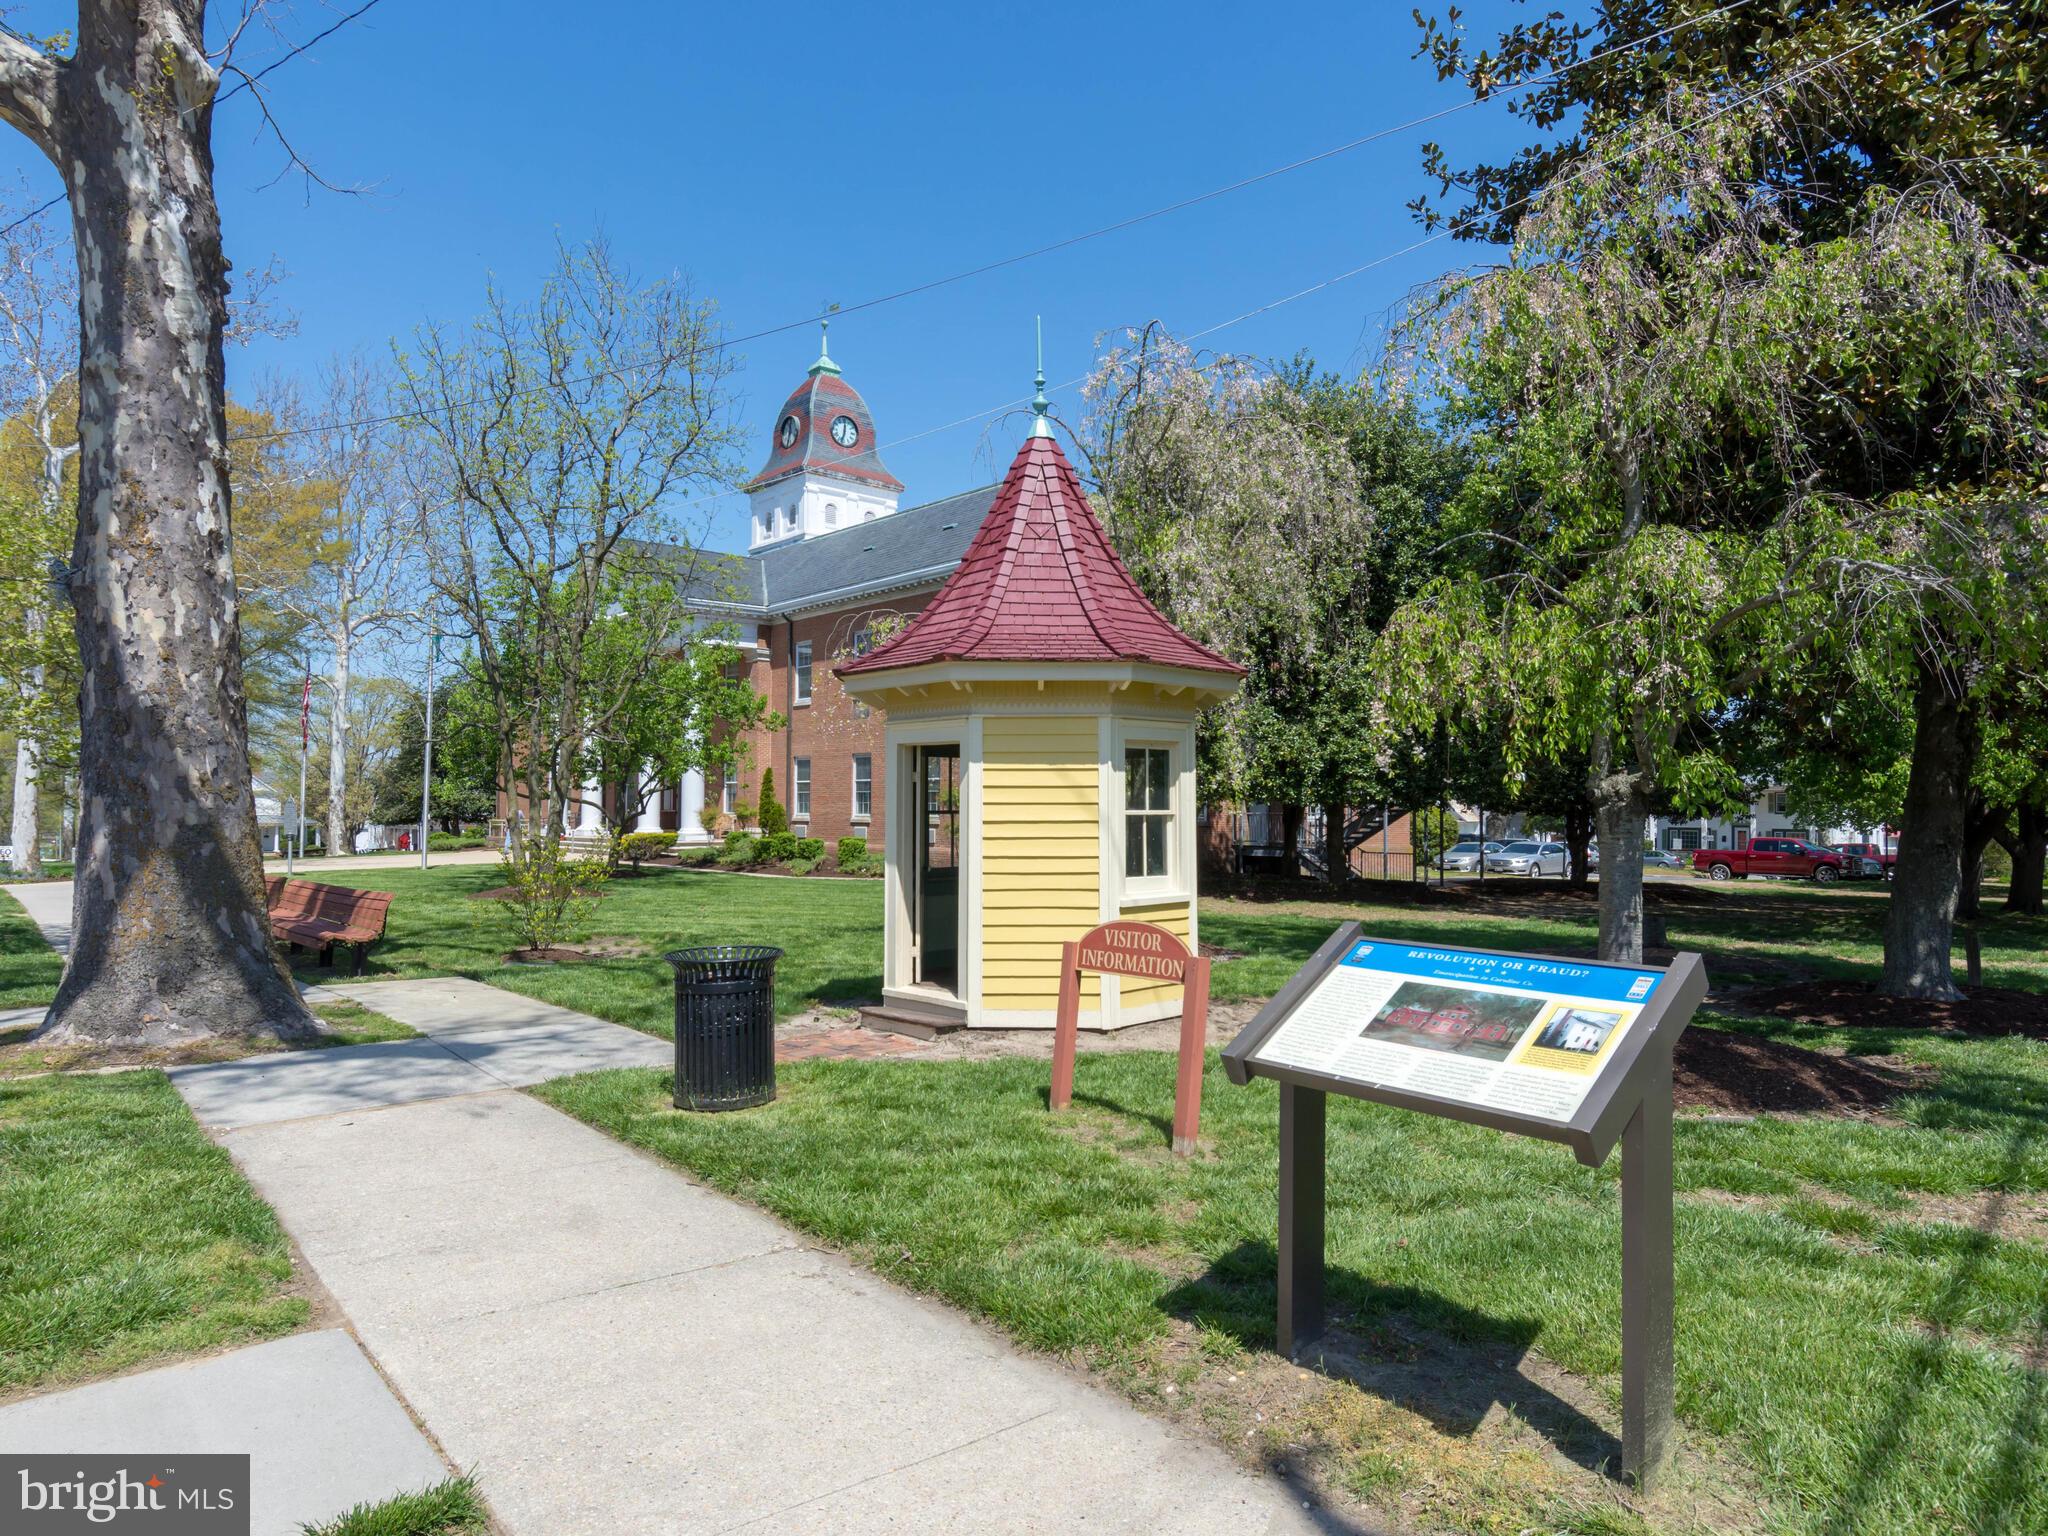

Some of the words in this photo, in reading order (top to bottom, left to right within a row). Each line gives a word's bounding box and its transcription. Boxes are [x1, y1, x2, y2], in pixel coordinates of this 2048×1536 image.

[1104, 928, 1162, 952] VISITOR
[1081, 948, 1184, 978] INFORMATION
[1408, 950, 1498, 967] REVOLUTION
[1502, 961, 1523, 970] OR
[1528, 964, 1590, 978] FRAUD?
